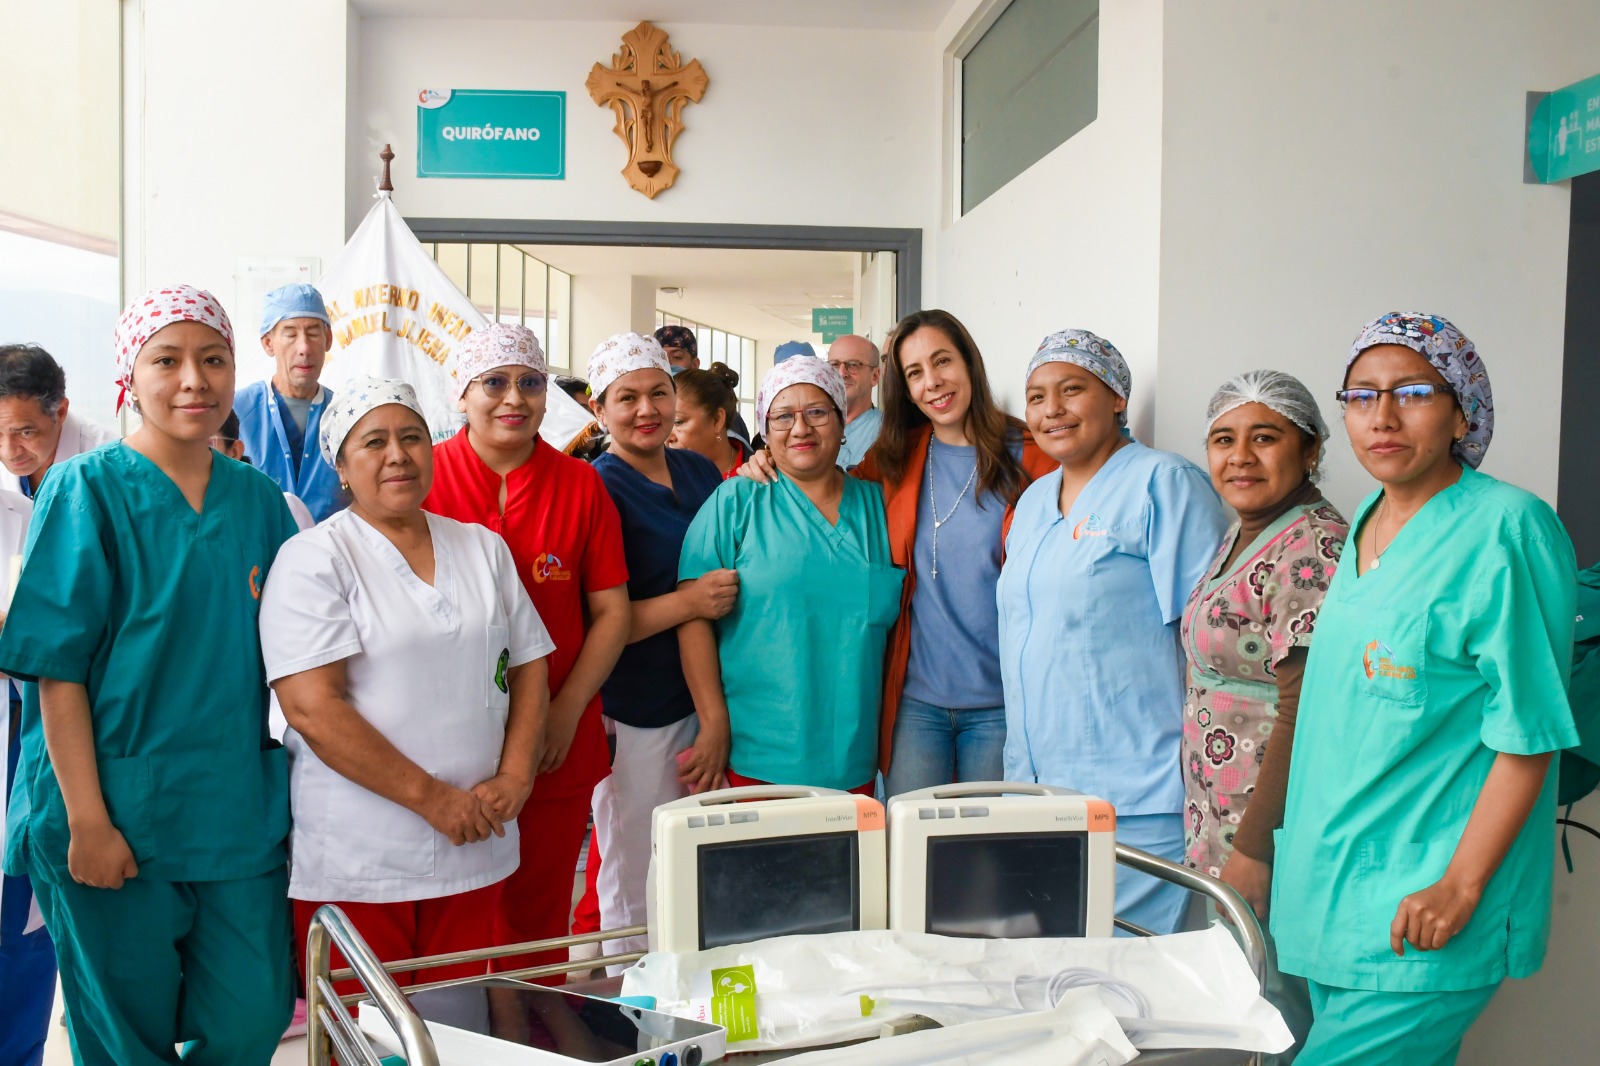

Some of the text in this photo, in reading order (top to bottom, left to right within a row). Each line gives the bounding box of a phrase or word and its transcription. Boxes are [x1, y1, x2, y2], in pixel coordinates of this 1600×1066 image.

[442, 123, 540, 142] QUIRÓFANO
[353, 283, 420, 311] MATERNO
[334, 311, 391, 349] MANUEL
